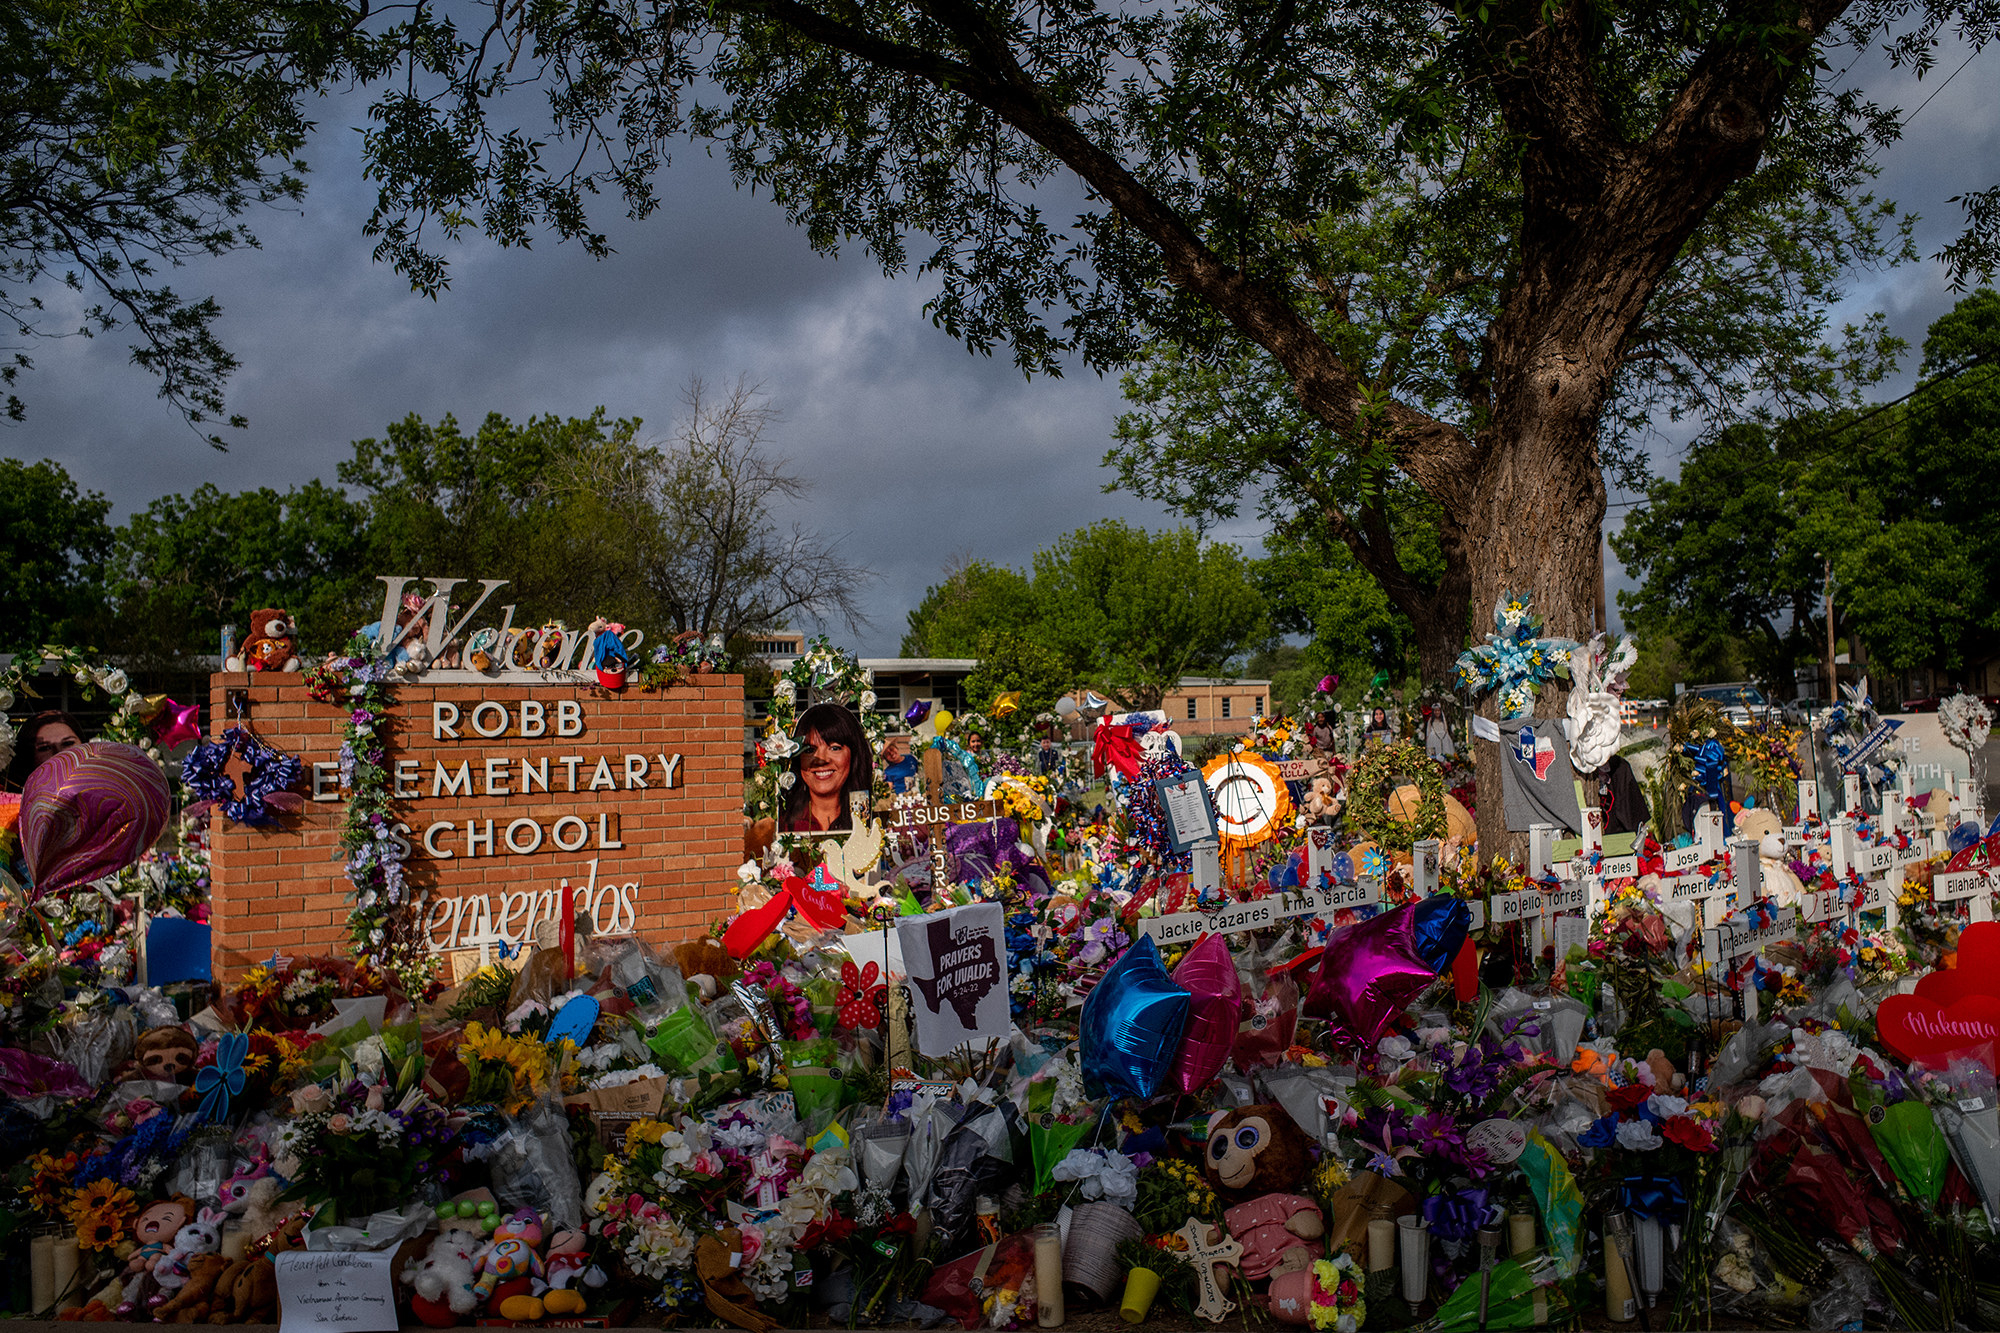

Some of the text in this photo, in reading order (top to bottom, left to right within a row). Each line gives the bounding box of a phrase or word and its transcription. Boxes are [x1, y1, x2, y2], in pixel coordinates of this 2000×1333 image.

[376, 575, 645, 673] Welcome
[433, 700, 584, 740] ROBB
[1903, 737, 1920, 753] FE
[1280, 768, 1310, 778] TULLA
[1291, 762, 1303, 770] OF
[313, 753, 681, 801] EEMENTARY
[892, 803, 977, 827] JESUS IS
[389, 813, 623, 862] SCHOOL
[1676, 852, 1699, 868] Jose
[1897, 843, 1922, 860] Rubio
[1602, 862, 1632, 875] ireles
[1947, 876, 1985, 894] Eliahana
[400, 858, 637, 950] ienvenidos
[1323, 886, 1366, 906] Garcia
[1547, 889, 1583, 908] Torres
[1158, 907, 1270, 941] Jackie Cazares
[940, 943, 982, 973] PRAYERS
[936, 962, 993, 999] FOR UVALDE
[953, 983, 979, 998] 5-24-22
[1902, 1009, 1999, 1040] Makenna
[891, 1081, 921, 1092] CARE
